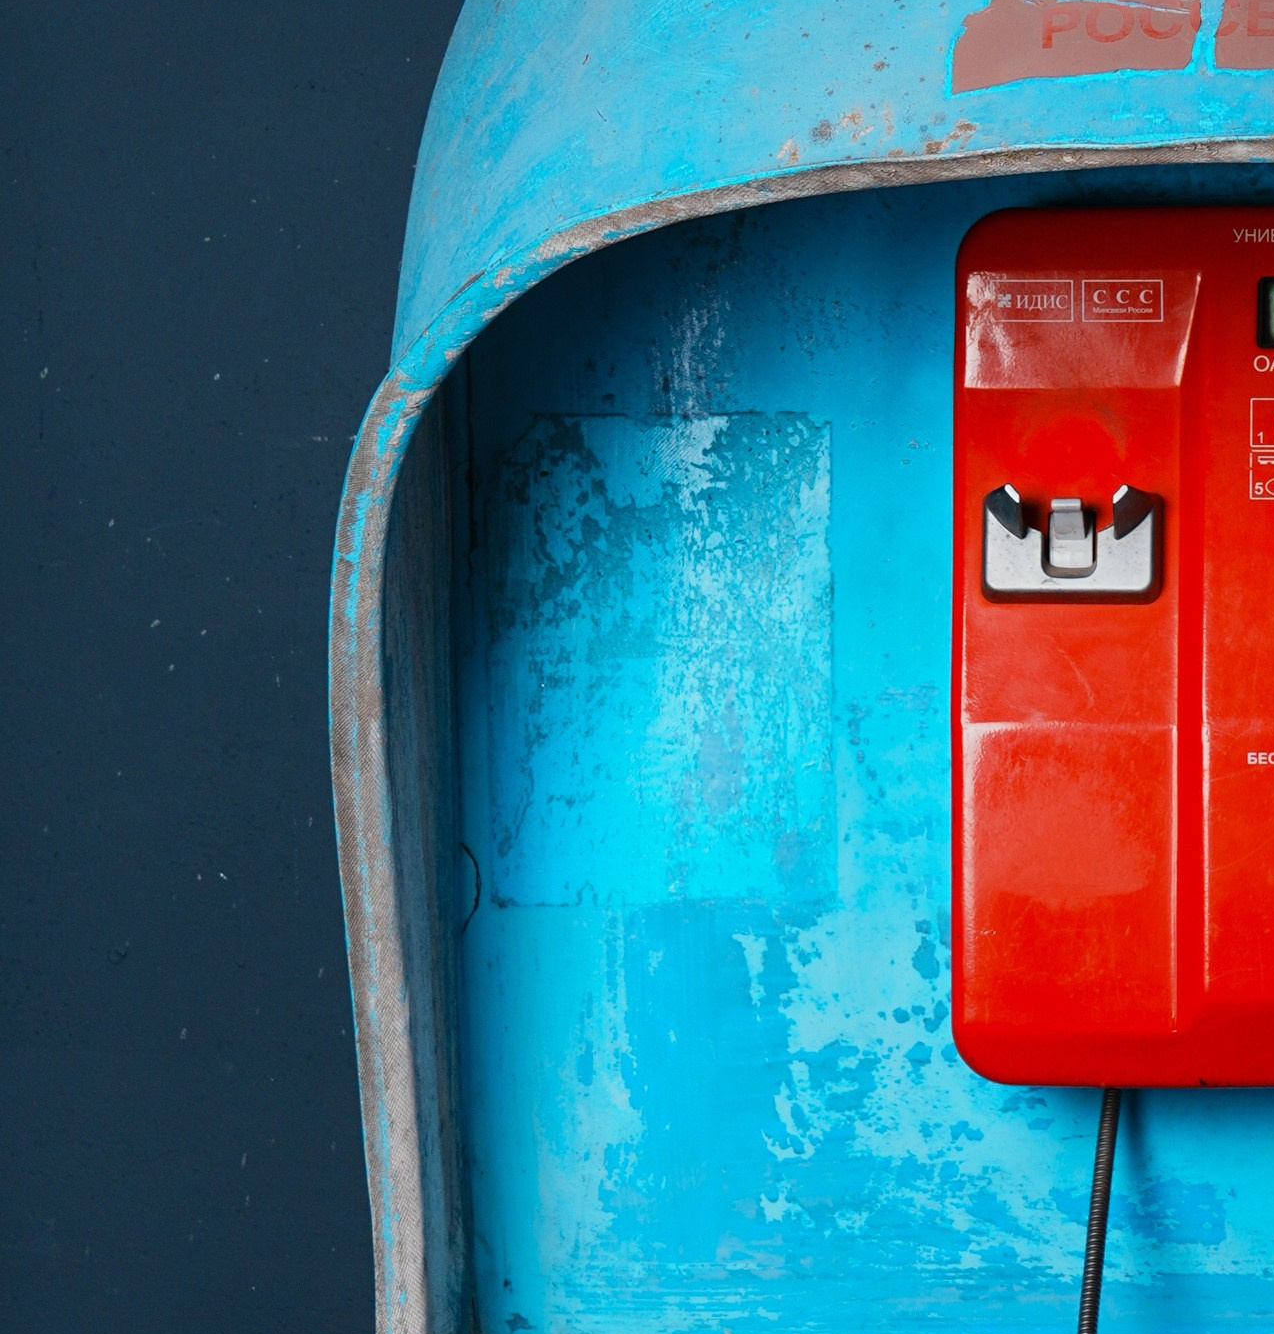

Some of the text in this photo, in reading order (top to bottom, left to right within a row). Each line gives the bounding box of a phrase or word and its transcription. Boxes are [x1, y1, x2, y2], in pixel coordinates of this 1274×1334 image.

[1016, 294, 1068, 311] ИДИС
[1257, 432, 1264, 444] 1
[1254, 482, 1264, 495] 5
